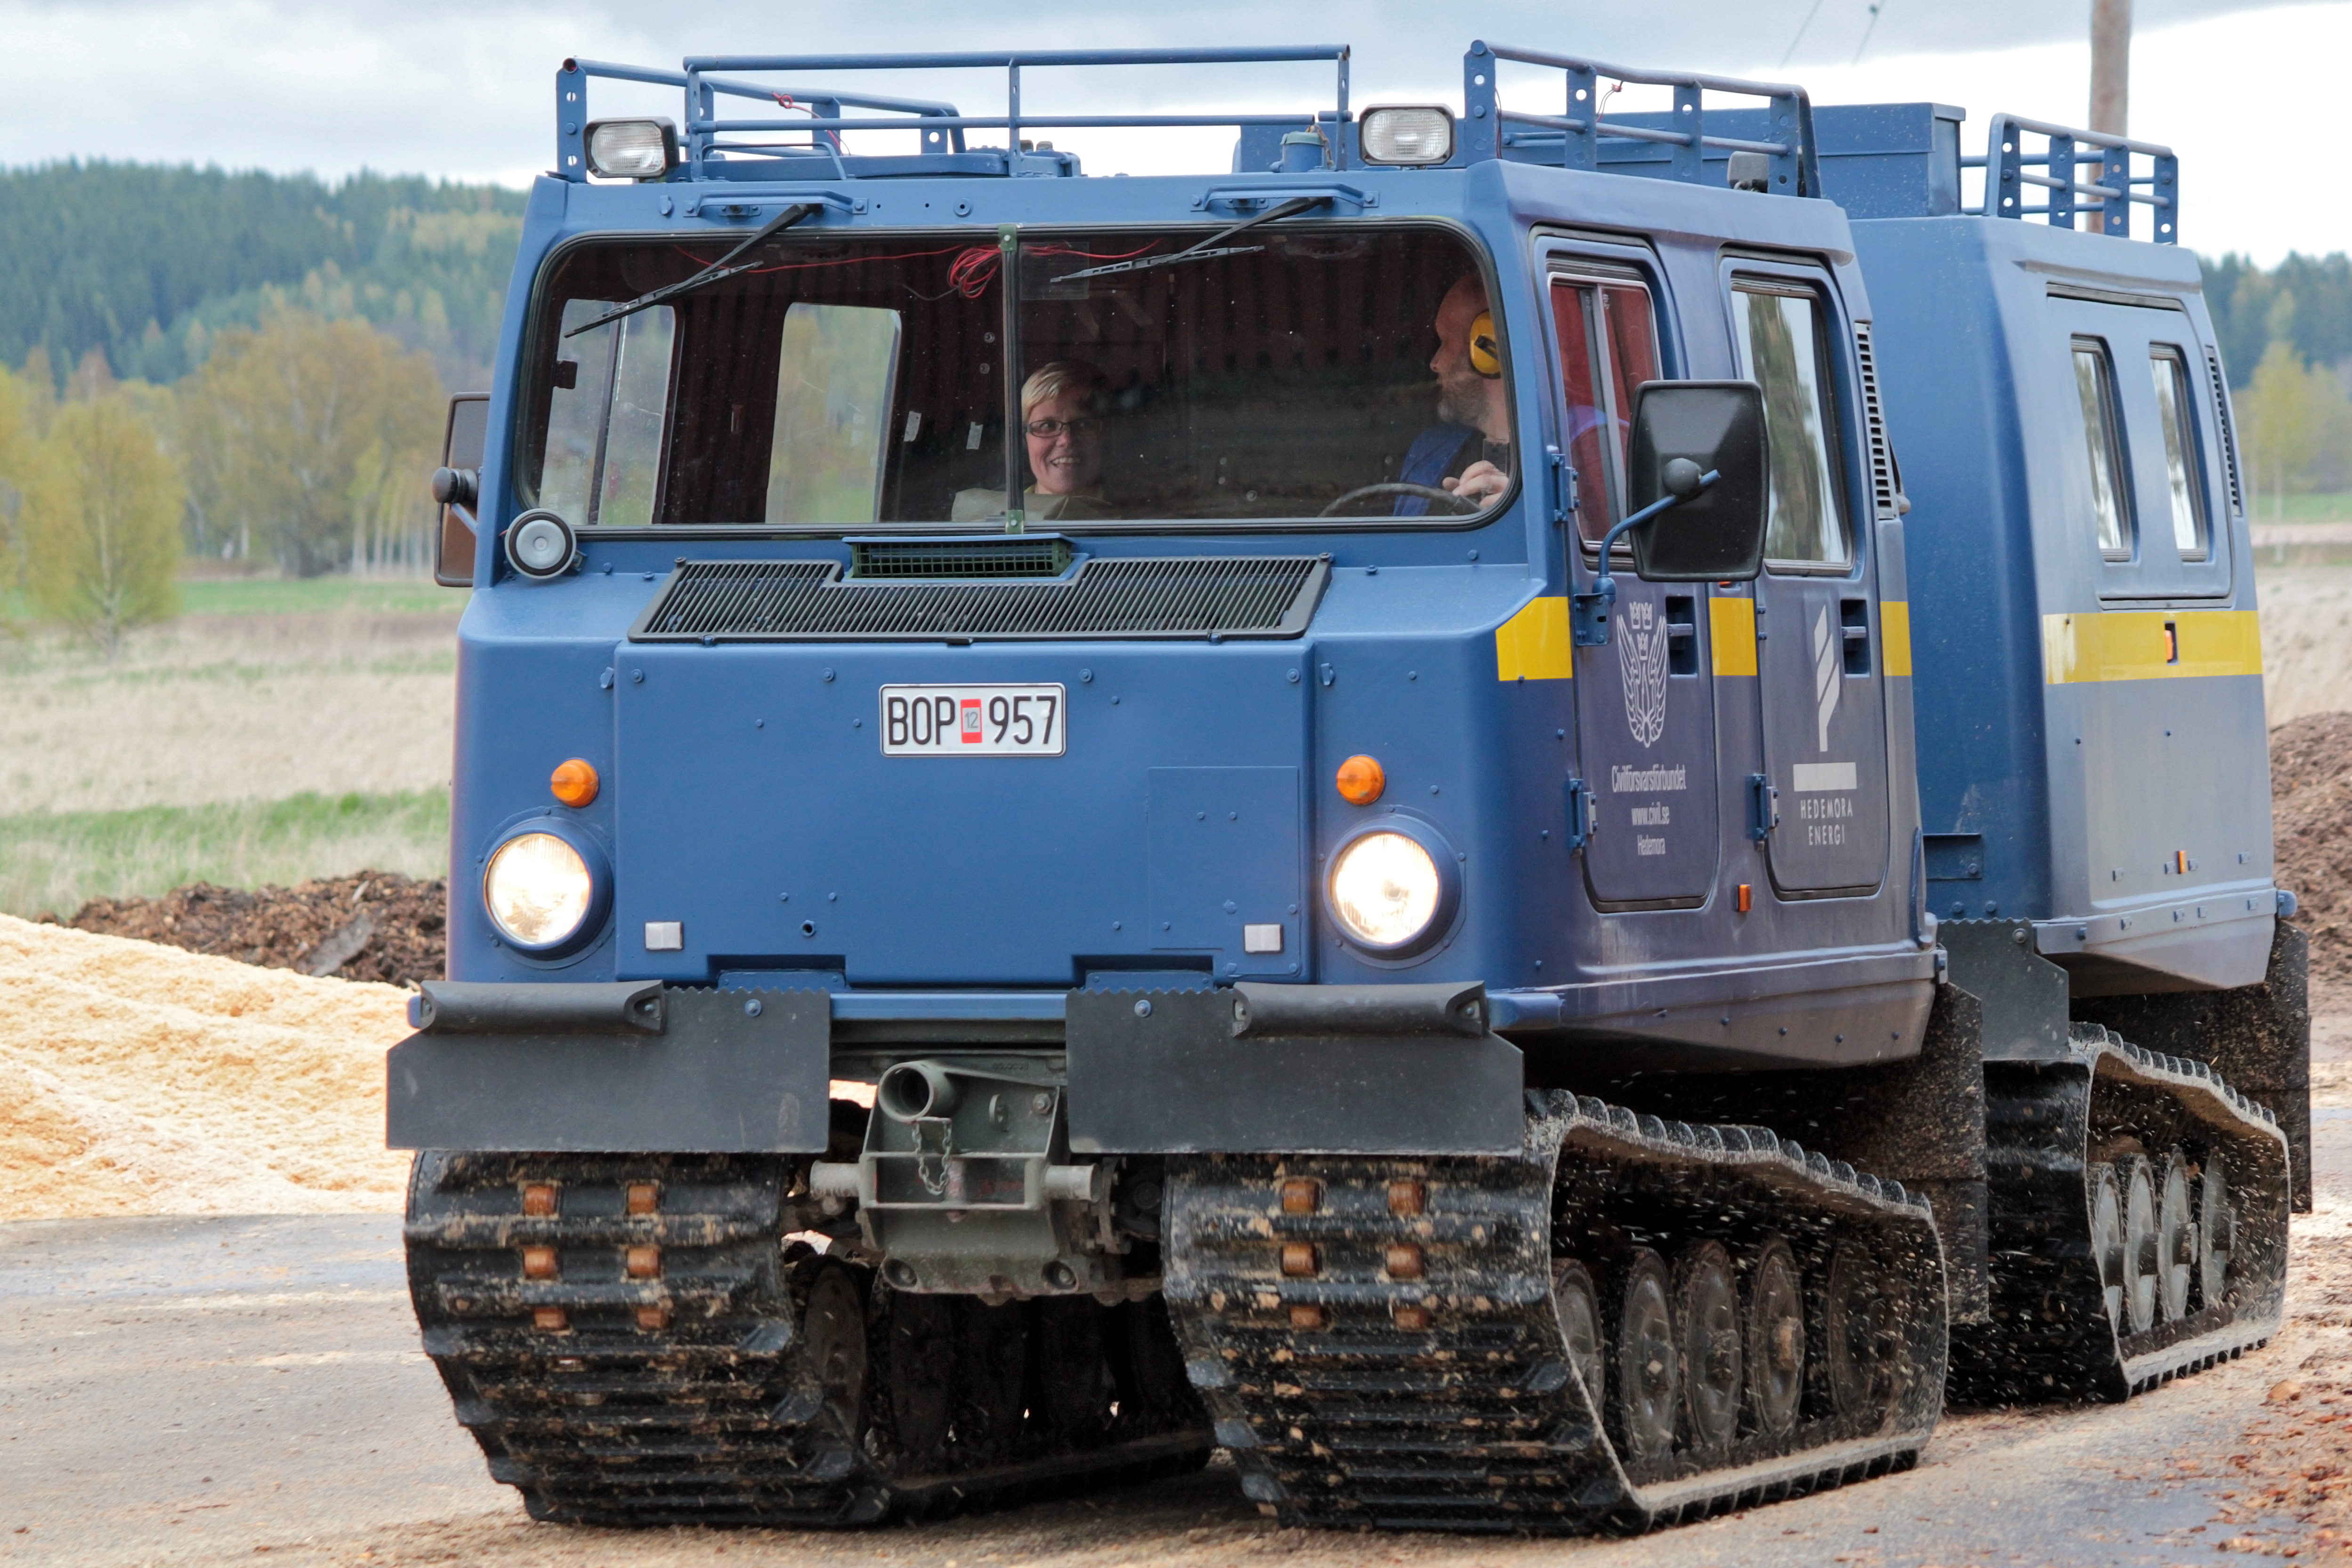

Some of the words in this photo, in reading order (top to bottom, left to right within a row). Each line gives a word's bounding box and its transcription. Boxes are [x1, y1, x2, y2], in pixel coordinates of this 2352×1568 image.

[888, 696, 955, 745] BOP
[989, 696, 1057, 744] 957
[964, 711, 979, 728] 12
[1631, 801, 1670, 825] www.civil.se
[1800, 798, 1853, 819] HEDEMORA
[1637, 834, 1666, 856] Hedemora
[1808, 824, 1845, 846] ENERGI
